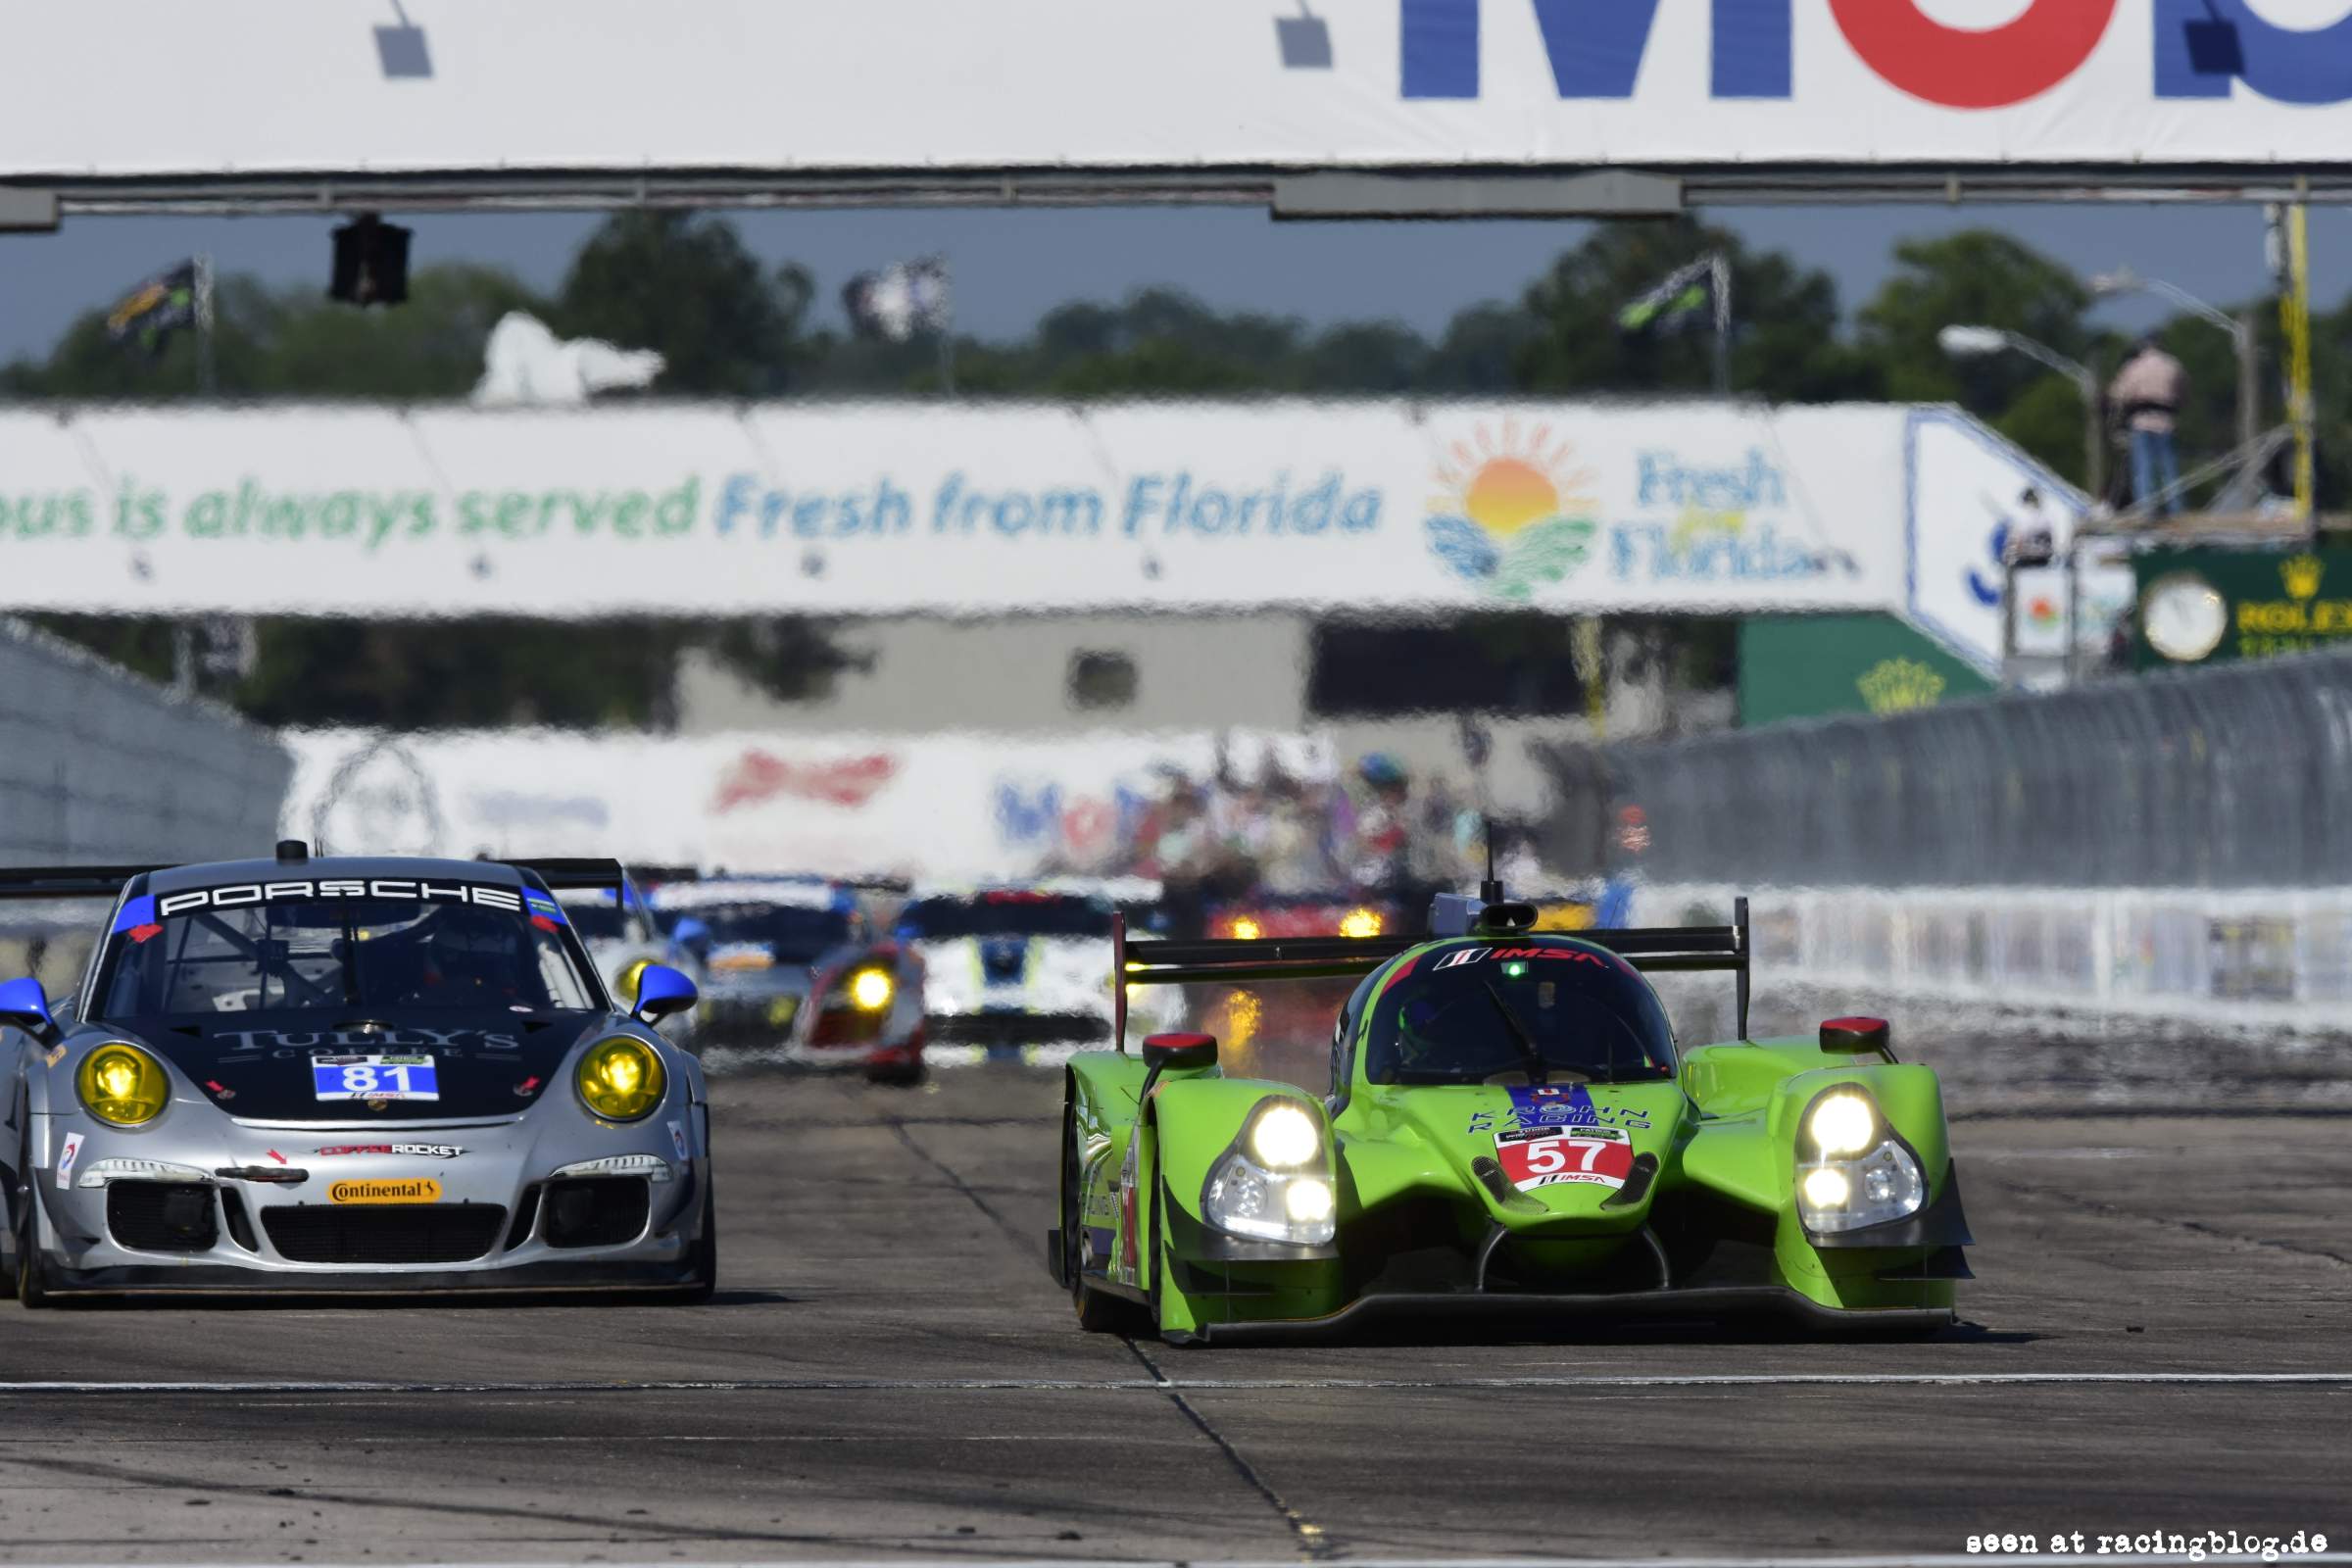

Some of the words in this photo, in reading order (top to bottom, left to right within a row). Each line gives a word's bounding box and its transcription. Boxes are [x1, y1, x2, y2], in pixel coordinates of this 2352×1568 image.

[111, 472, 167, 539] is
[183, 475, 437, 556] always
[455, 475, 700, 538] served
[713, 473, 912, 538] Fresh
[930, 472, 1104, 538] from
[1121, 470, 1384, 538] Florida
[160, 879, 521, 916] PORSCHE
[1490, 948, 1609, 969] IMSA
[342, 1065, 411, 1092] 81
[1467, 1114, 1652, 1133] RACING
[1472, 1104, 1650, 1120] KROHN
[1527, 1141, 1607, 1174] 57
[332, 1182, 421, 1201] Continental
